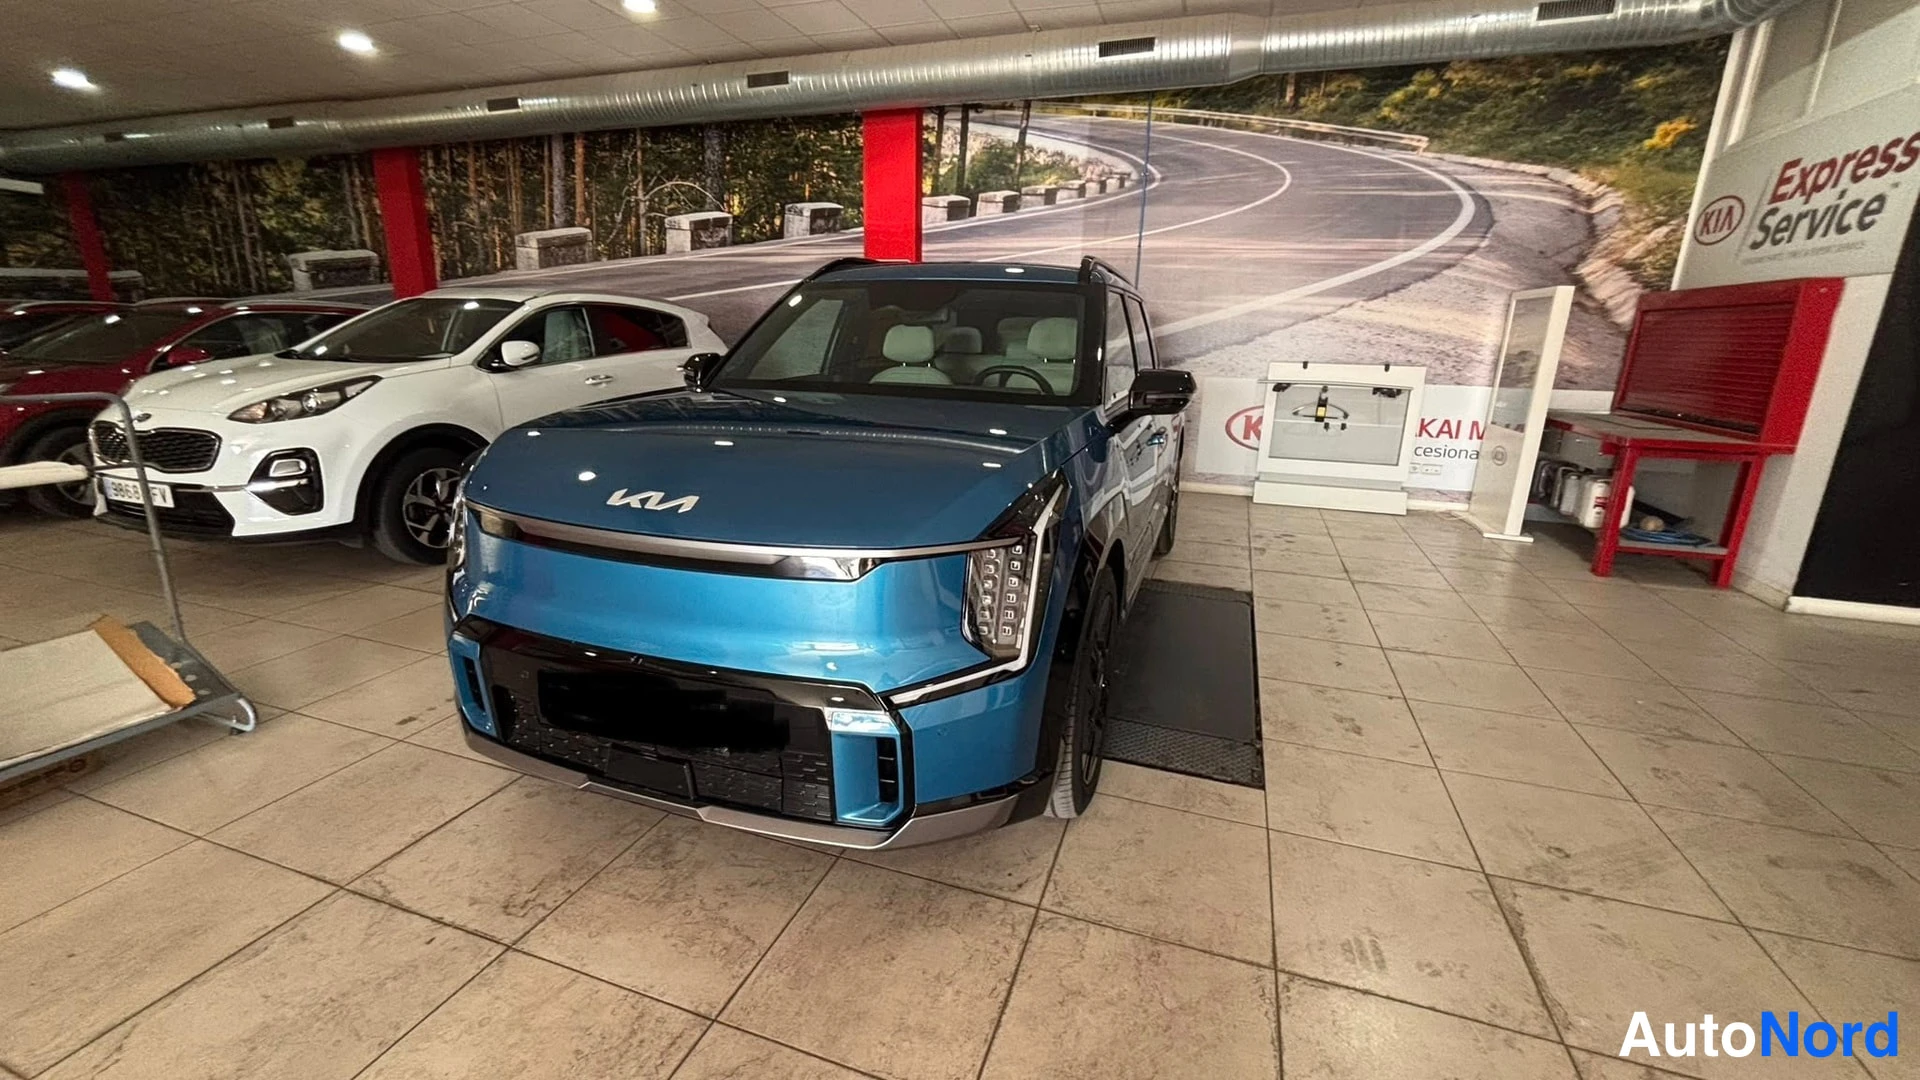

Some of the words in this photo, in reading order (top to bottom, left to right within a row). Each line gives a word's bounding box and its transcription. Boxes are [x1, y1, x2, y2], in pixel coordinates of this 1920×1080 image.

[1766, 131, 1920, 205] Express
[1699, 205, 1735, 236] KIA
[1750, 188, 1887, 250] Service
[1415, 417, 1462, 440] KAI
[606, 488, 700, 514] KIA
